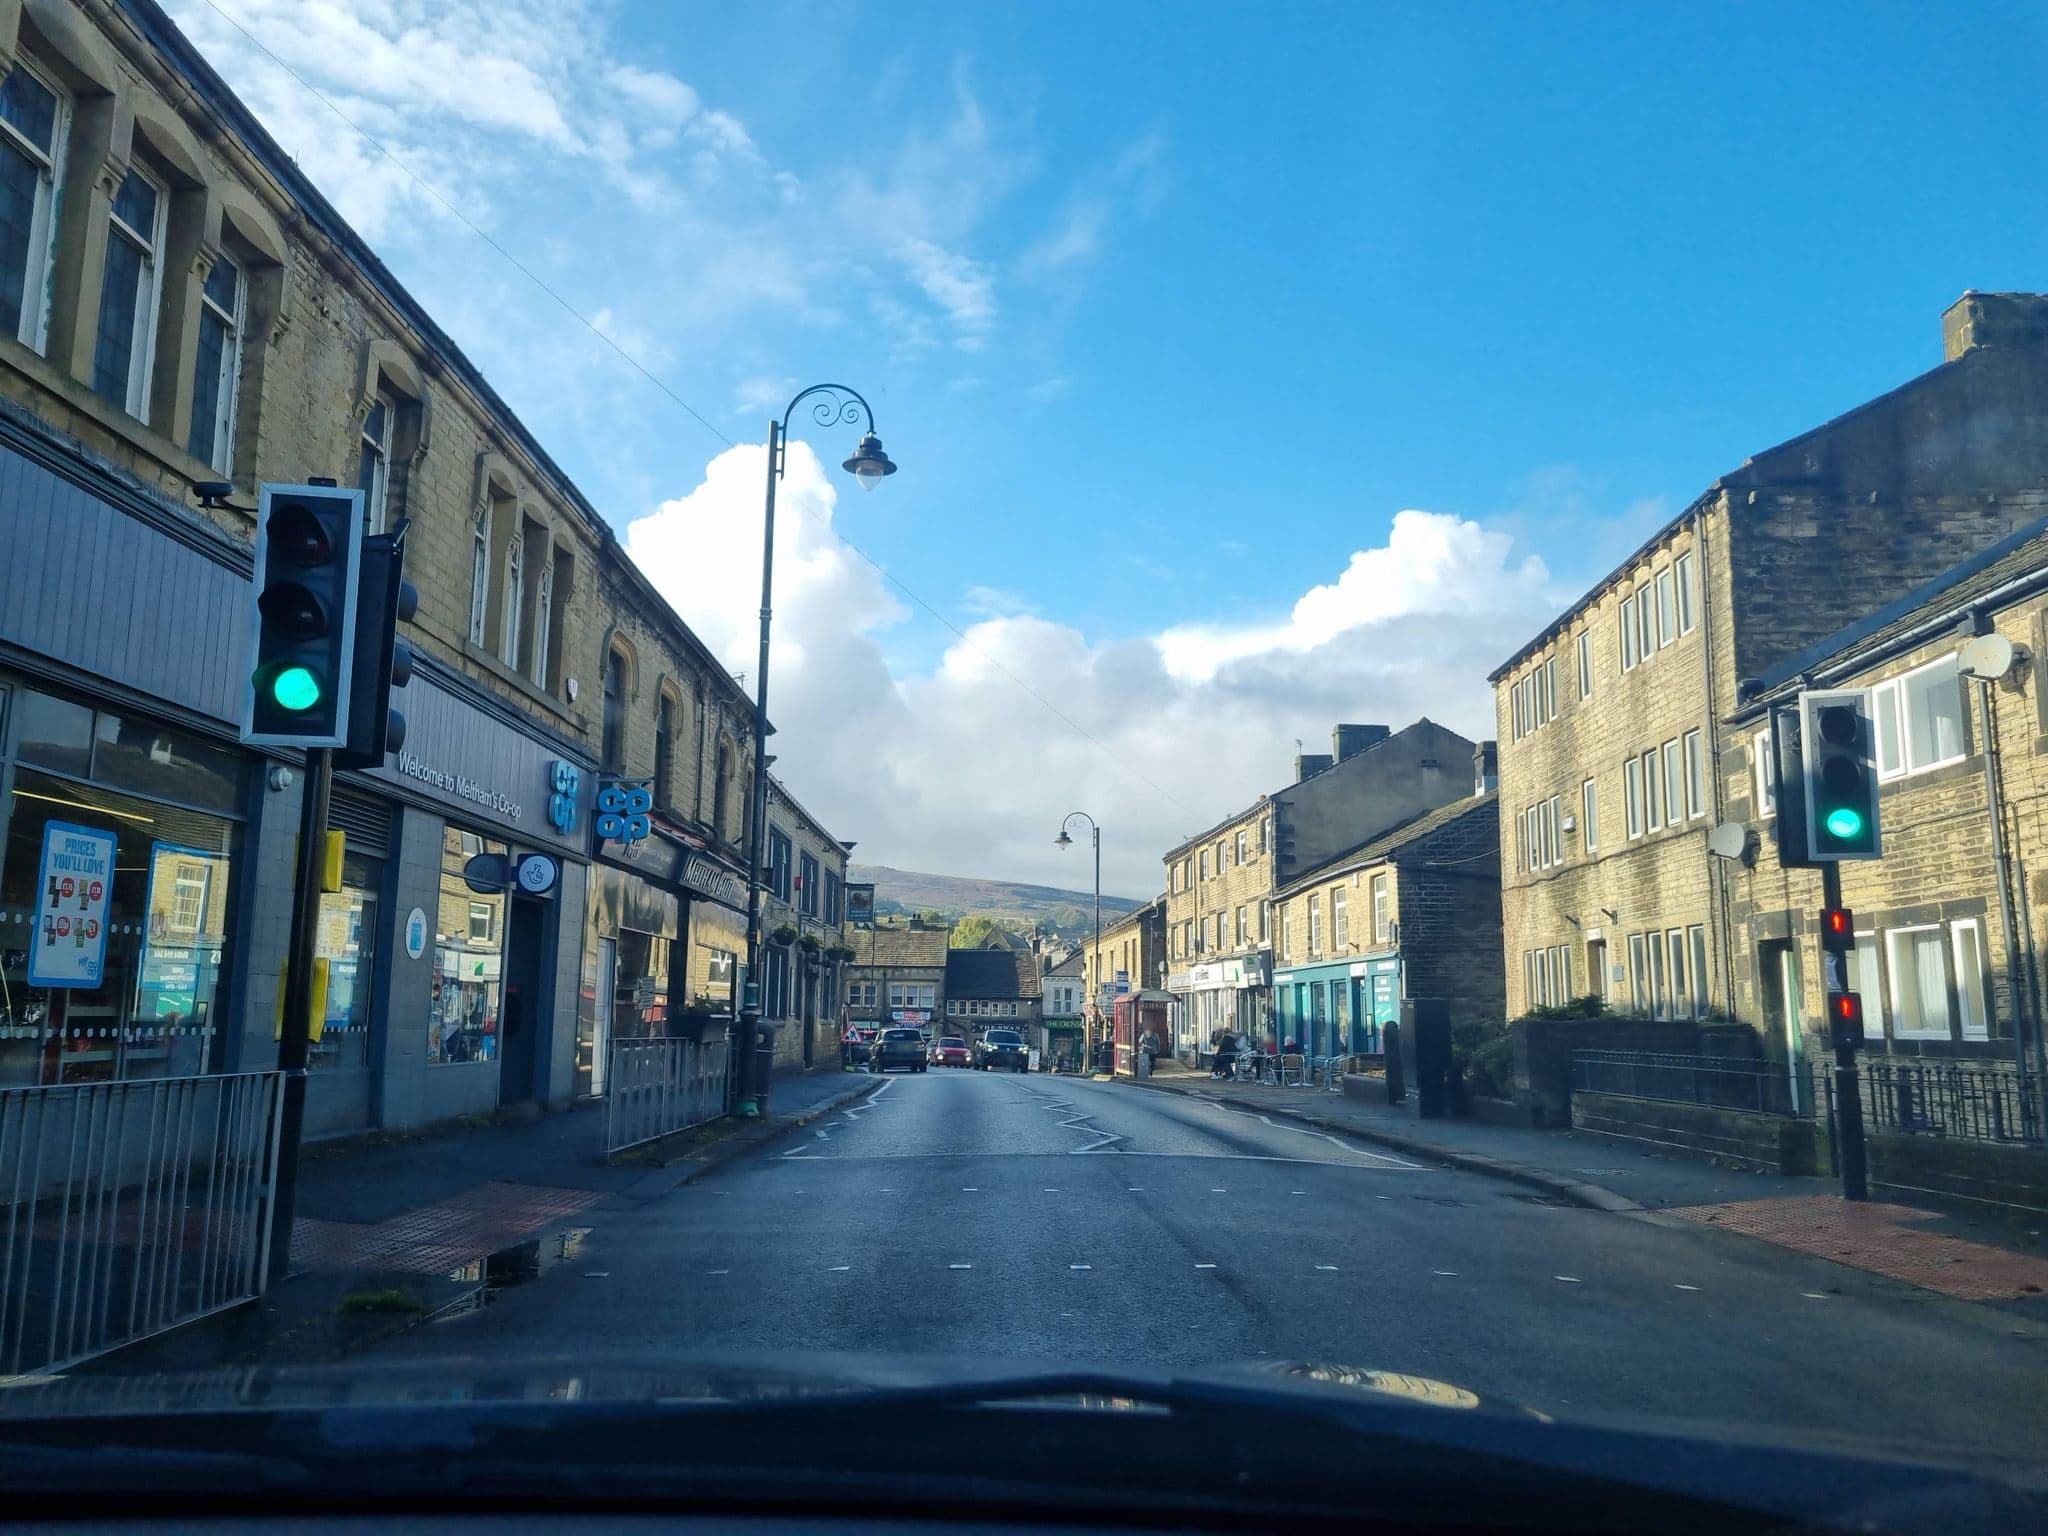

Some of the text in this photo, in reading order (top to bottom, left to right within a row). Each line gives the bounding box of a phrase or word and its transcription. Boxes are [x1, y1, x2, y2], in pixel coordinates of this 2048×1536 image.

[399, 749, 521, 824] Welcome to Meltham's Co-op
[65, 838, 97, 857] PRICES
[53, 853, 105, 875] YOU'LL LOVE
